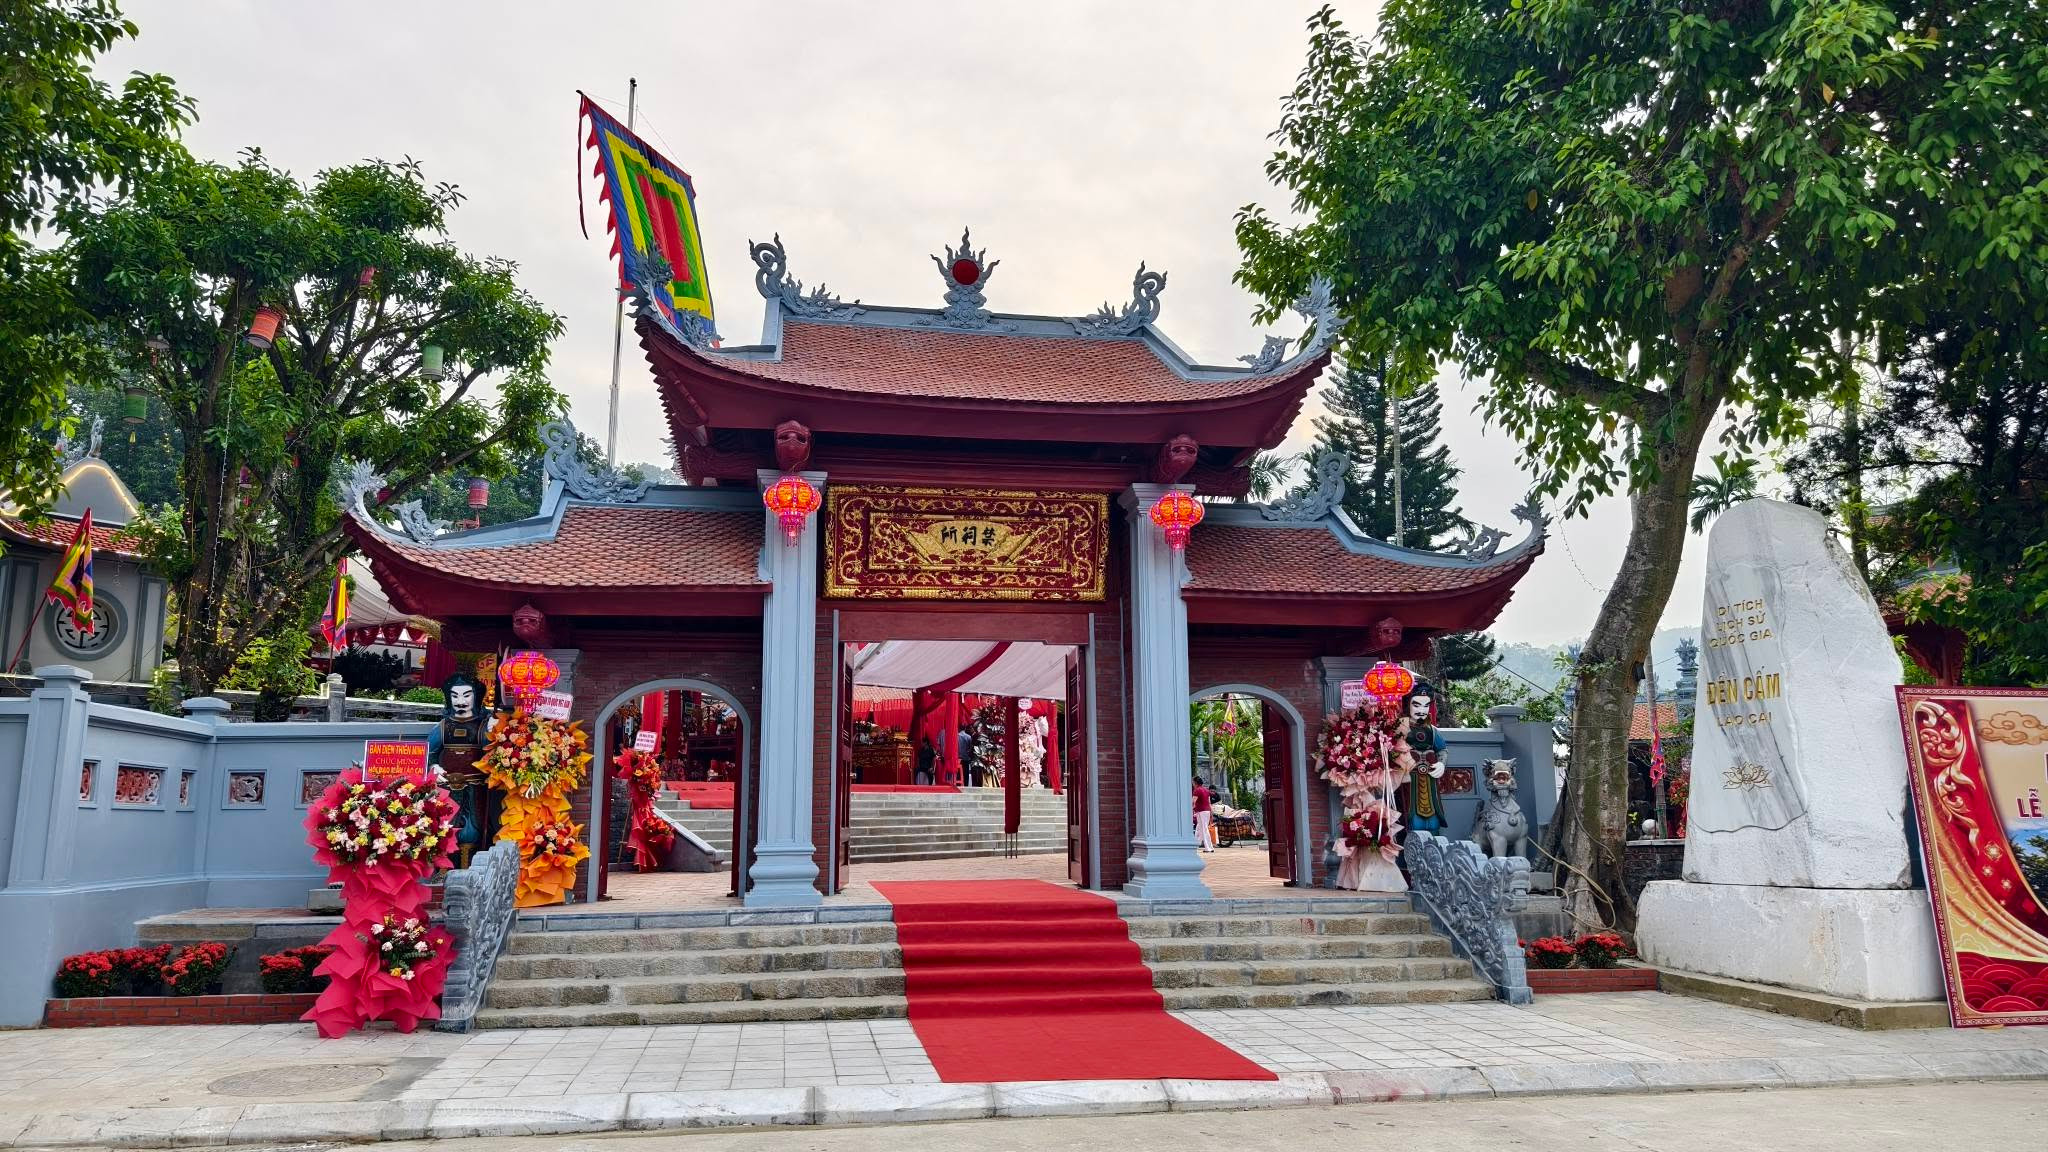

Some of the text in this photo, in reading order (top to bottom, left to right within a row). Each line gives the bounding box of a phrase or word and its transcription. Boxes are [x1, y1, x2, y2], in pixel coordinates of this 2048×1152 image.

[1733, 599, 1764, 612] TÍCH
[1715, 611, 1767, 634] LỊCH SỬ
[1709, 628, 1774, 649] QUỐC GIA
[1706, 665, 1782, 706] ĐỀN CẤM
[1748, 711, 1773, 726] CAI
[2016, 787, 2043, 818] LỄ
